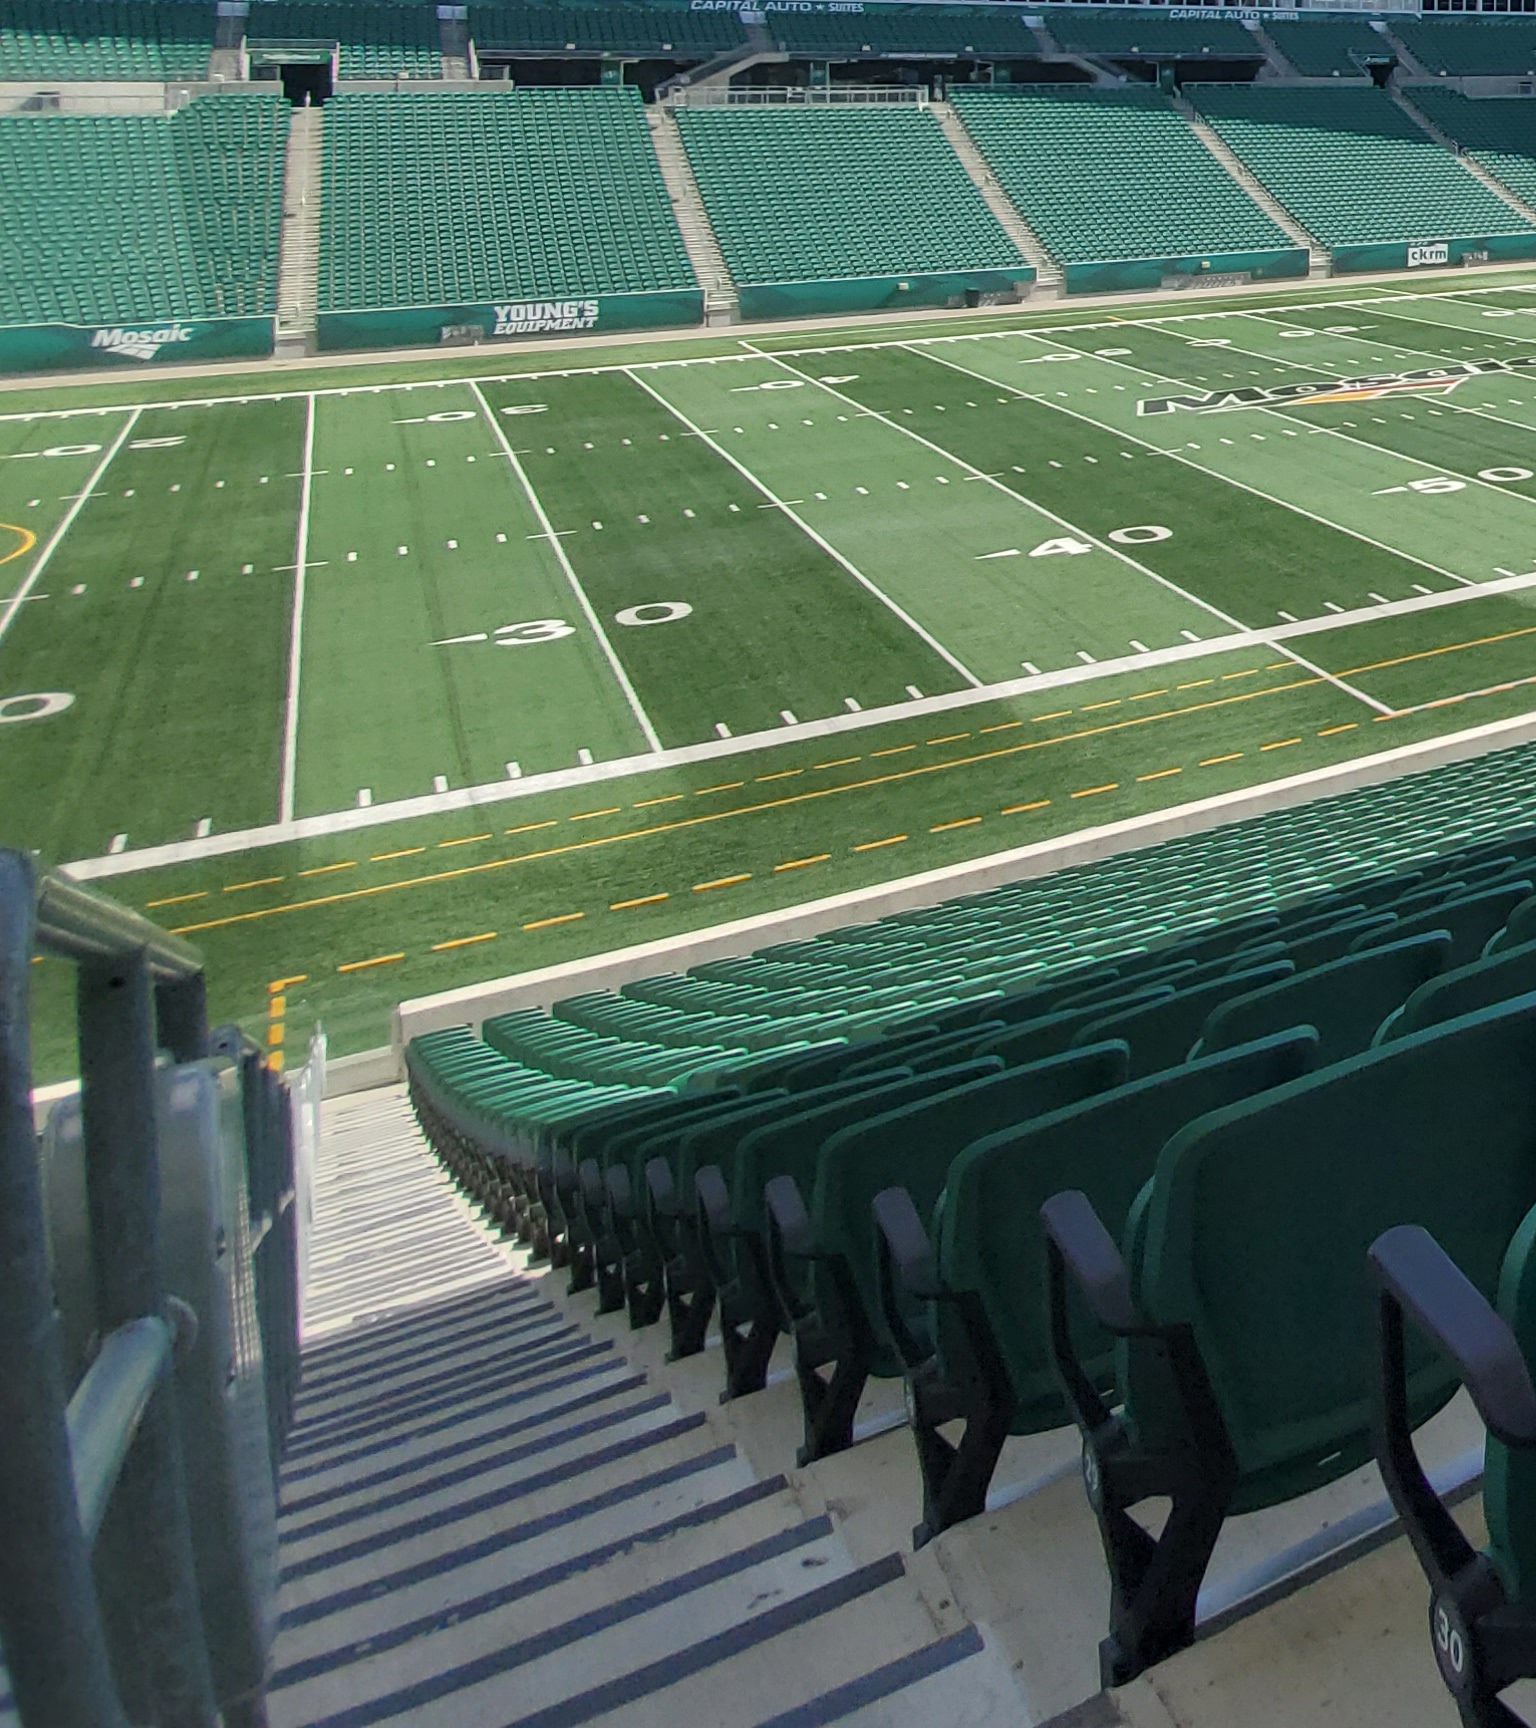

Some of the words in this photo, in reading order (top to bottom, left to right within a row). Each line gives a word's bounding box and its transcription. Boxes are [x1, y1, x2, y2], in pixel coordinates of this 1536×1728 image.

[690, 0, 761, 12] CAPITAL
[765, 1, 812, 12] AUTO
[829, 2, 864, 13] SUITES
[1169, 9, 1222, 20] CAPITAL
[1225, 10, 1260, 20] AUTO
[1272, 12, 1299, 21] SUITES
[1411, 249, 1447, 261] ckrm
[493, 300, 599, 323] YOUNG'S
[91, 324, 196, 348] Mosaic
[493, 317, 599, 335] EQUIPMENT
[1407, 466, 1534, 495] 50
[1027, 524, 1173, 558] 40
[493, 601, 693, 640] 30
[1438, 1607, 1463, 1673] 30
